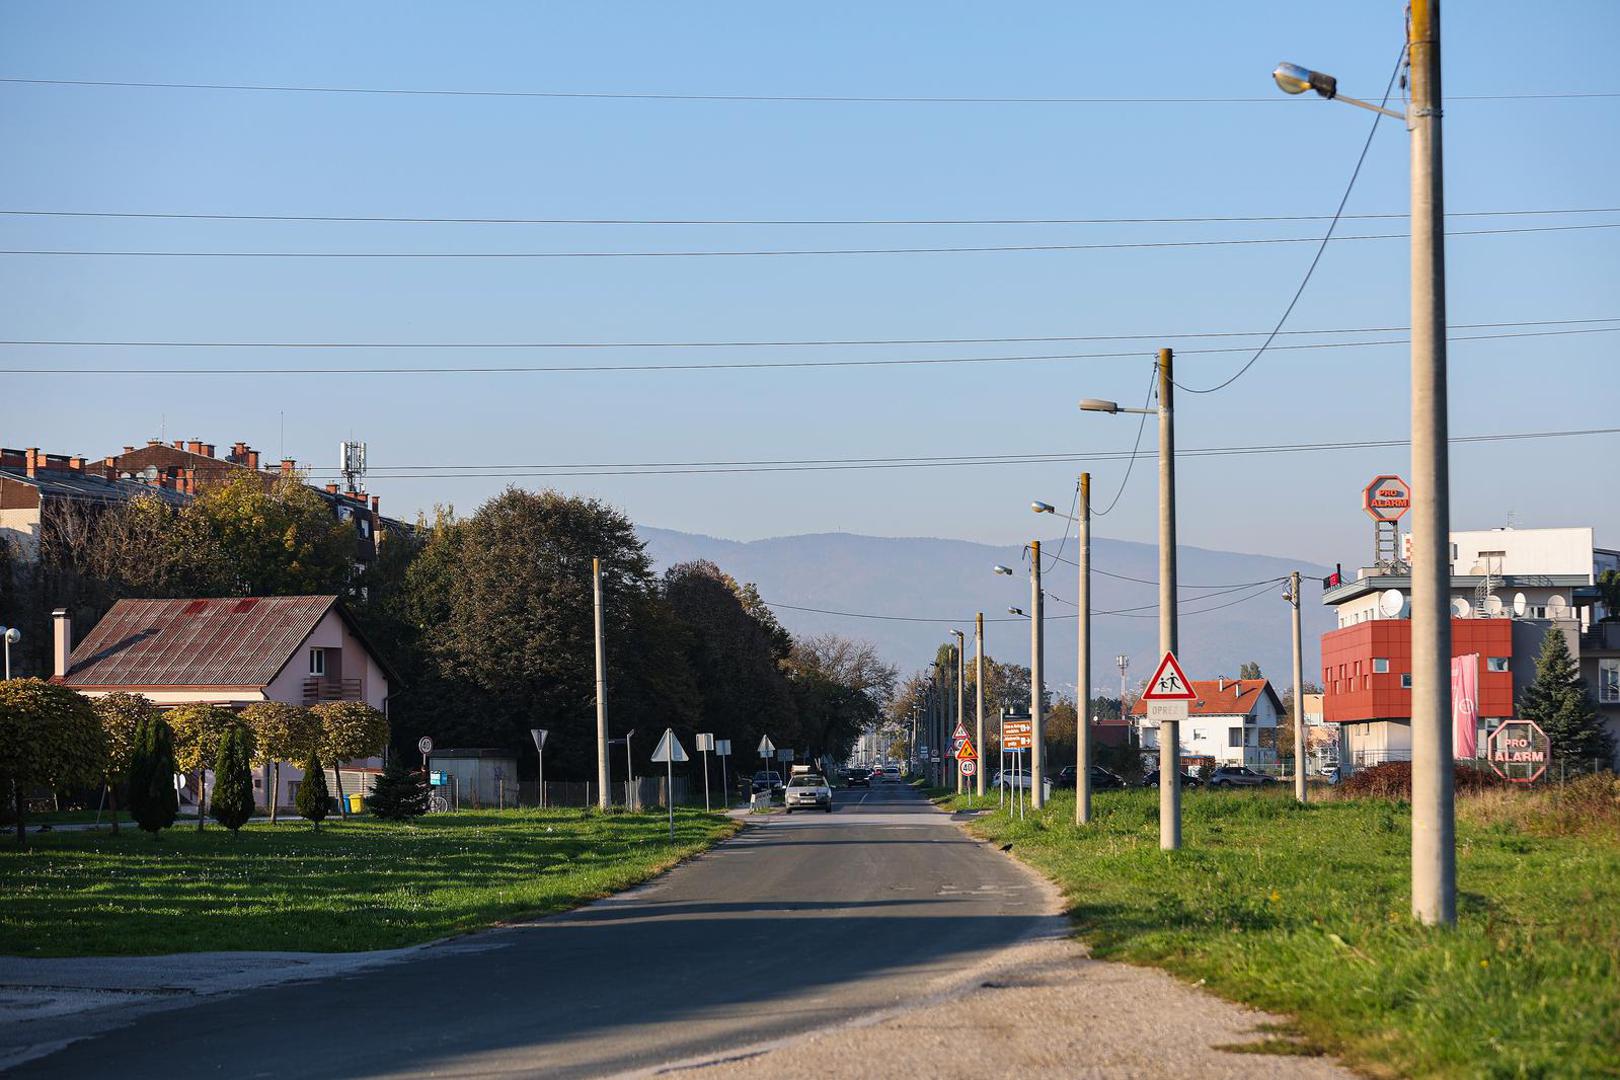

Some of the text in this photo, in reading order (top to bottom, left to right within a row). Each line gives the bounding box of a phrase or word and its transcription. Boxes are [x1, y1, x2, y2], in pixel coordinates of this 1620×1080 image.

[1379, 489, 1397, 497] PRO
[1372, 499, 1407, 508] ALARM
[1505, 739, 1527, 747] PRO
[1495, 752, 1543, 762] ALARM
[963, 763, 972, 771] 40
